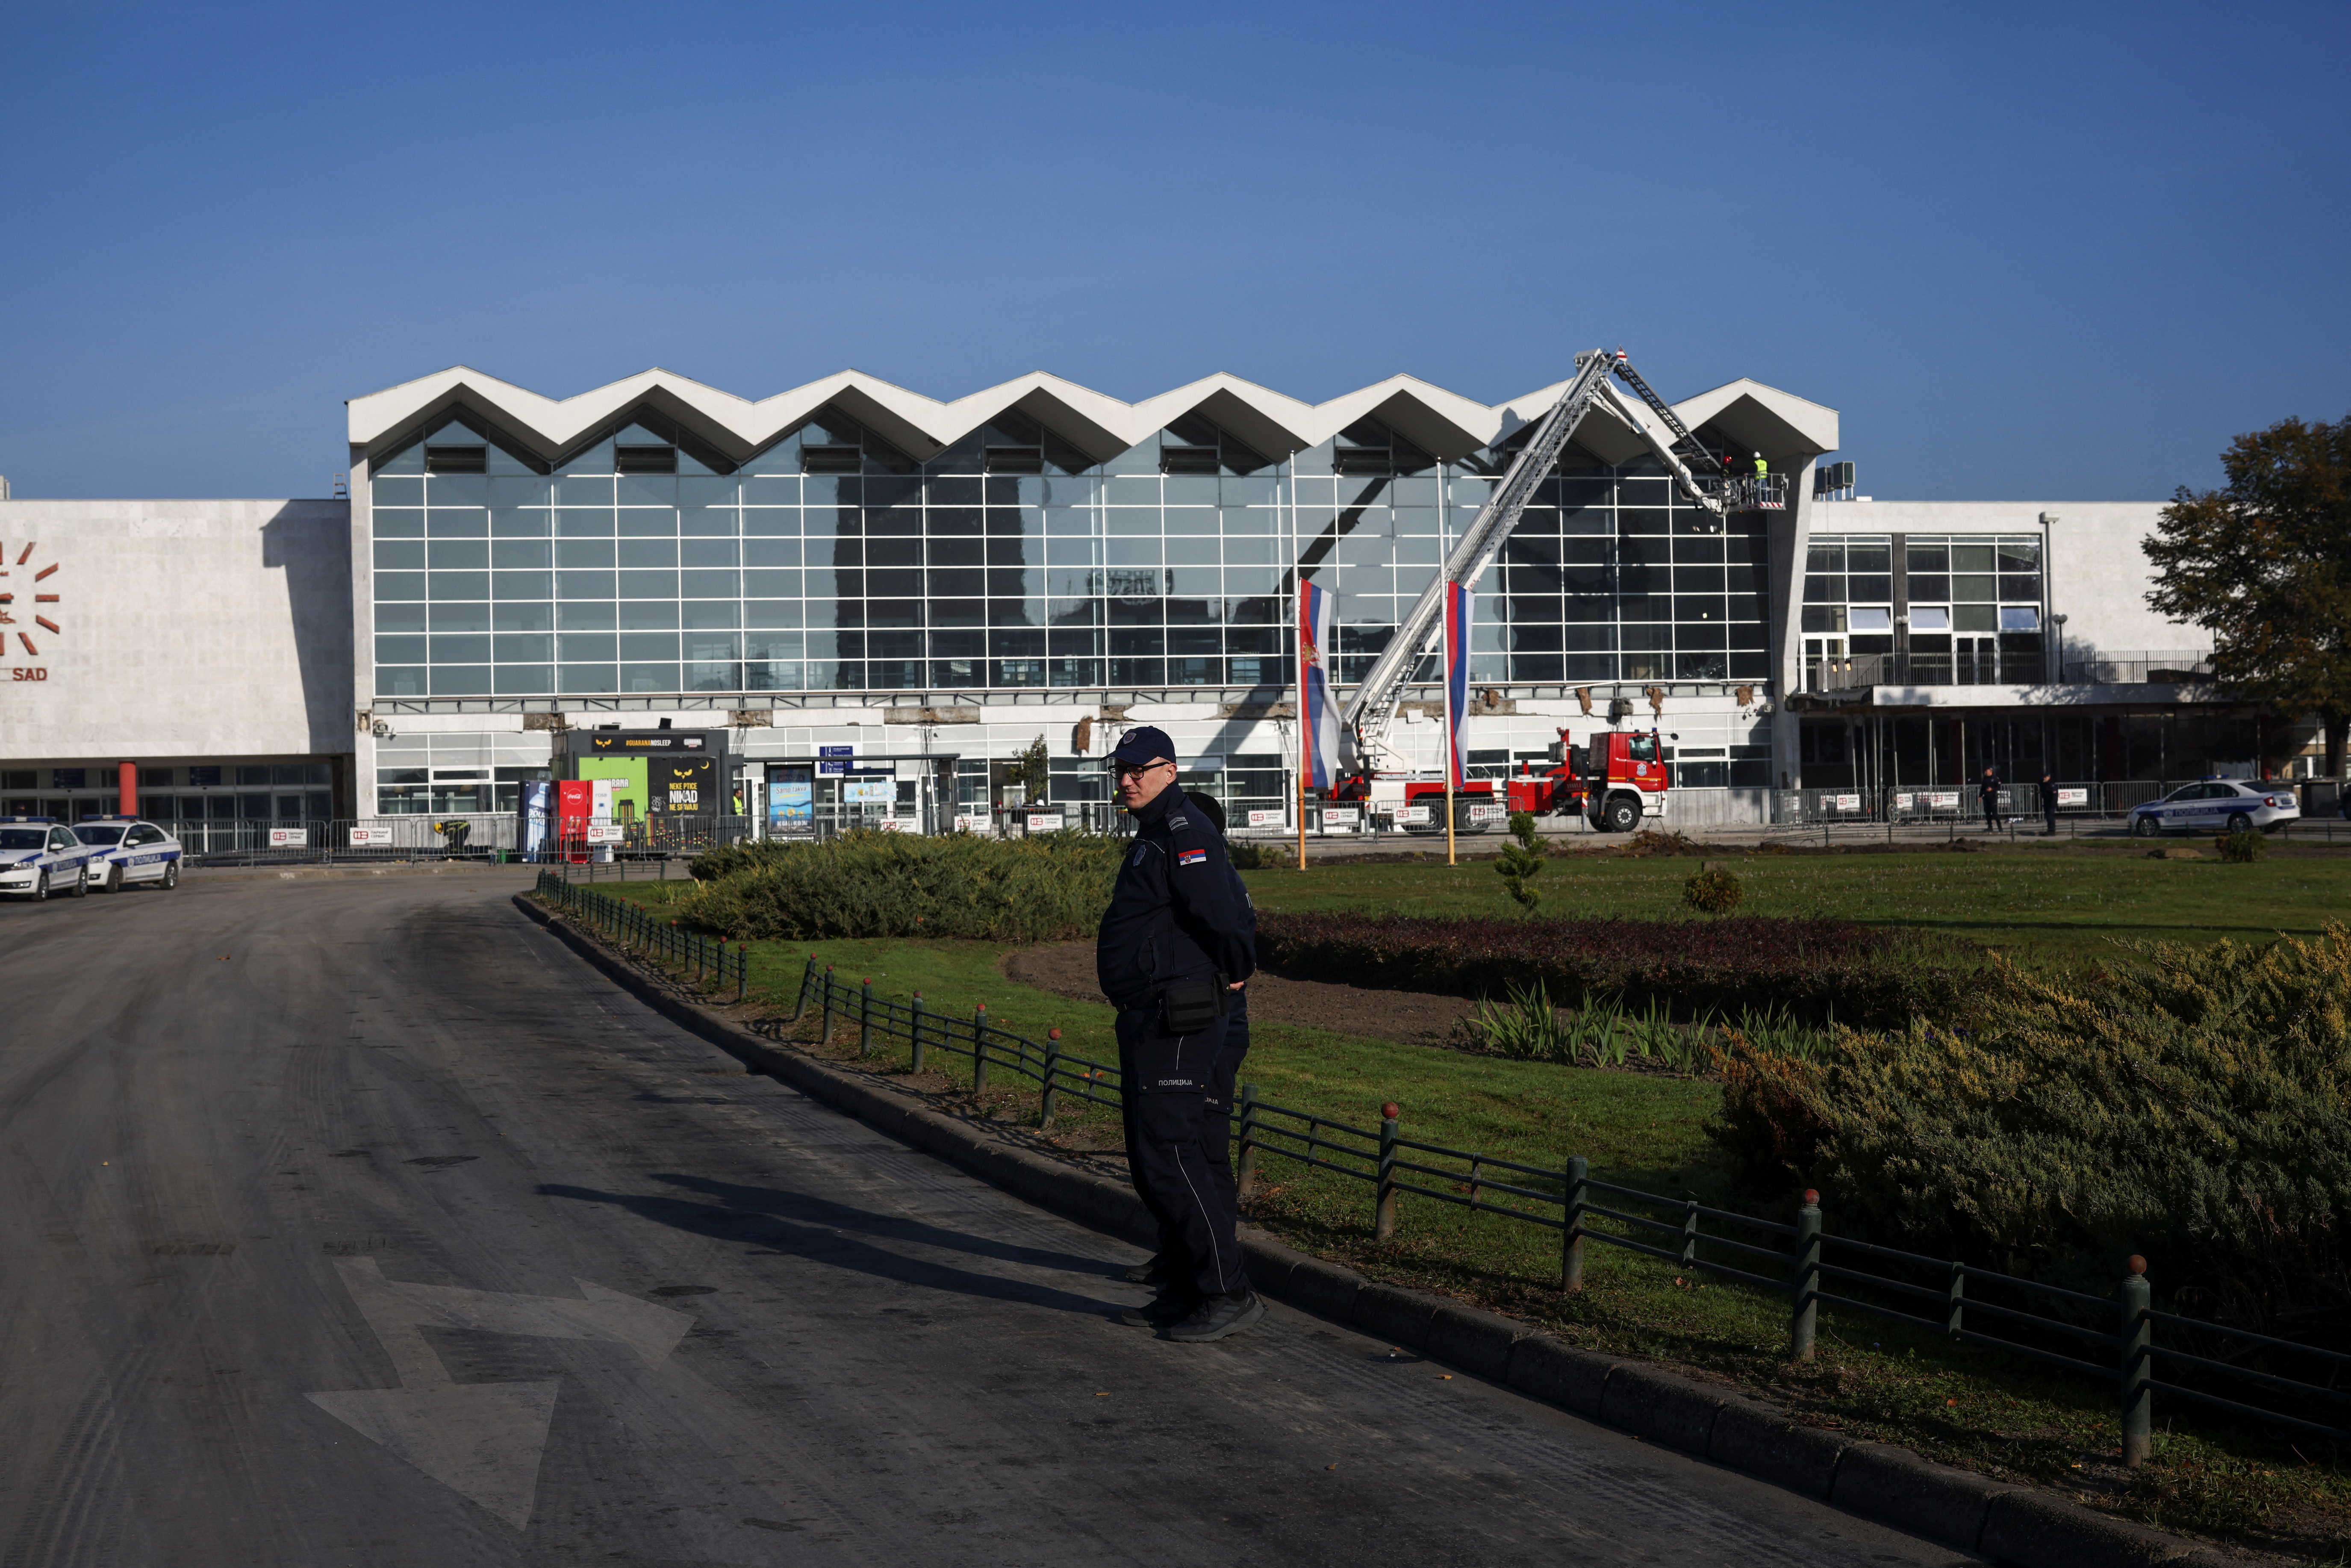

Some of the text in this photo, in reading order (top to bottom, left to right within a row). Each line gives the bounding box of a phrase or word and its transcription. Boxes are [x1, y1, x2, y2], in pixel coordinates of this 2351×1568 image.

[13, 668, 47, 681] SAD
[669, 790, 698, 803] NIKAD
[2176, 807, 2219, 817] ПОЛИЦИЈА
[135, 854, 161, 865] ПОЛИЦИЈА
